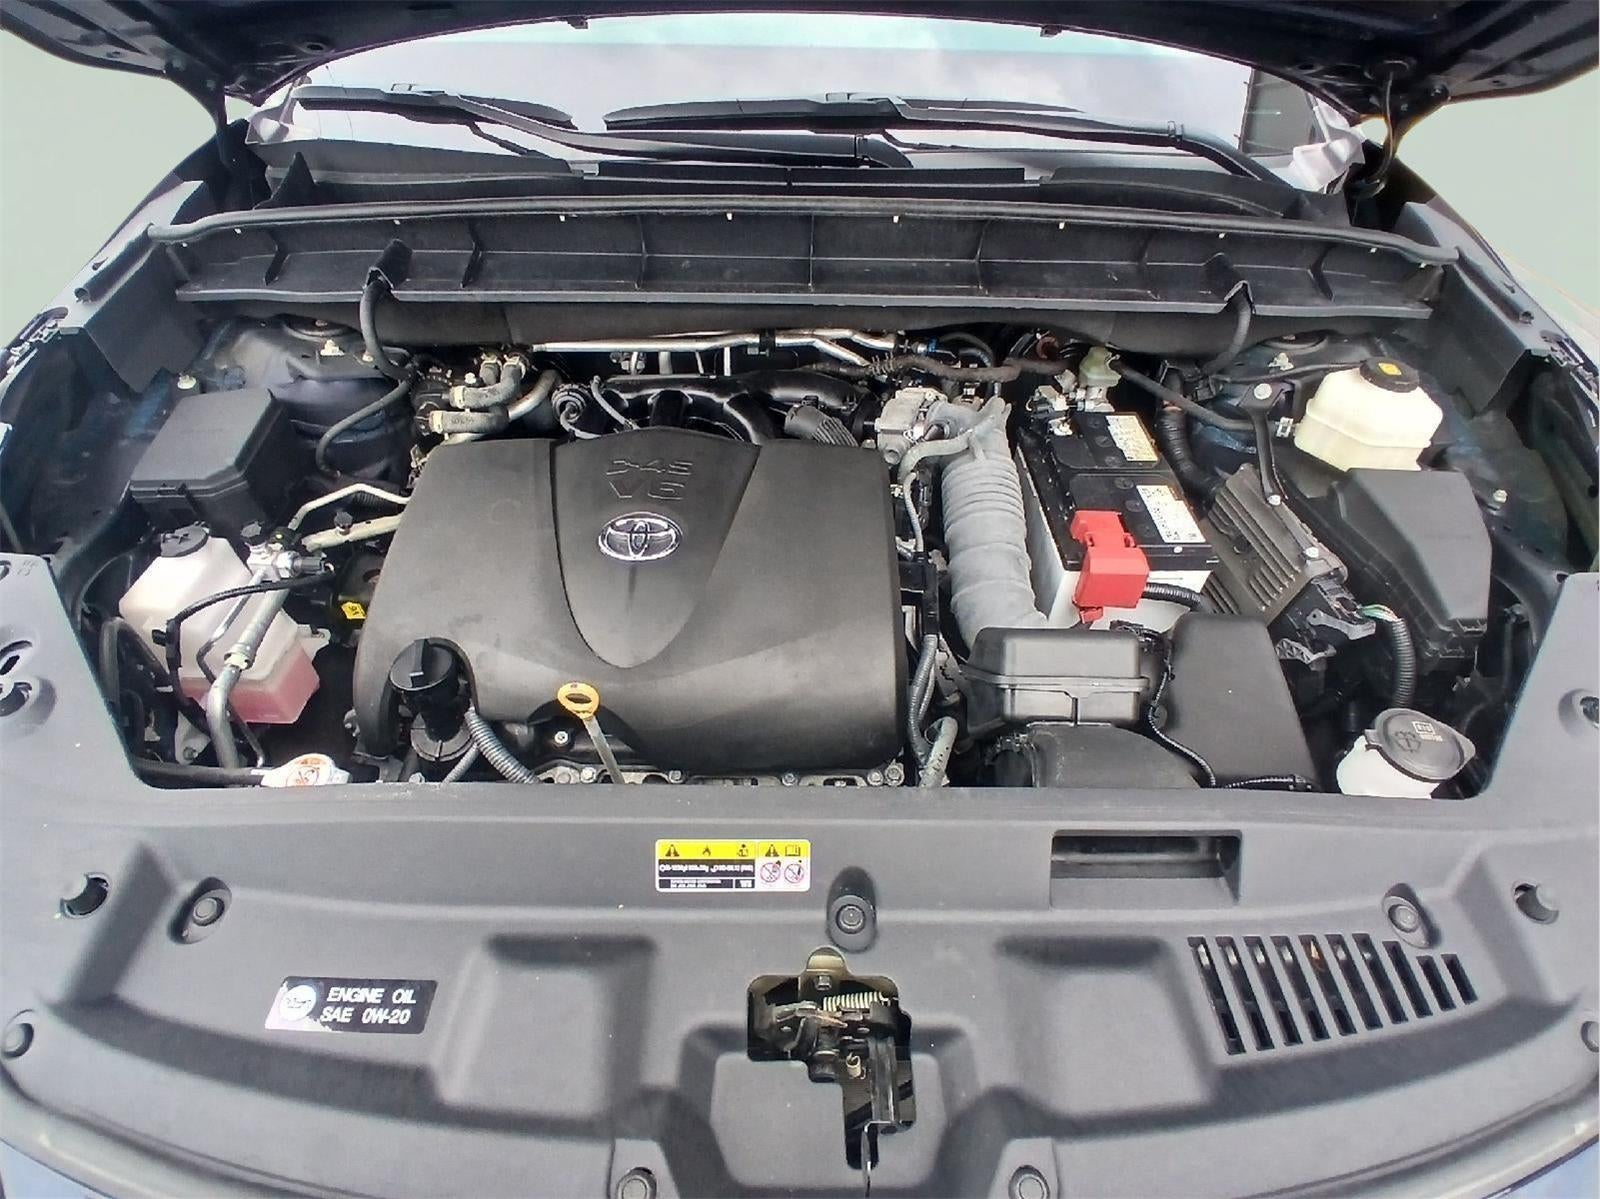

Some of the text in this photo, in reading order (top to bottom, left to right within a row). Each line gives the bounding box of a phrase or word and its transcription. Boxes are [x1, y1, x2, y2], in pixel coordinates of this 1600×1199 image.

[607, 480, 686, 501] V6
[327, 987, 417, 1004] ENGINE OIL
[320, 1007, 411, 1025] SAE 0W-20
